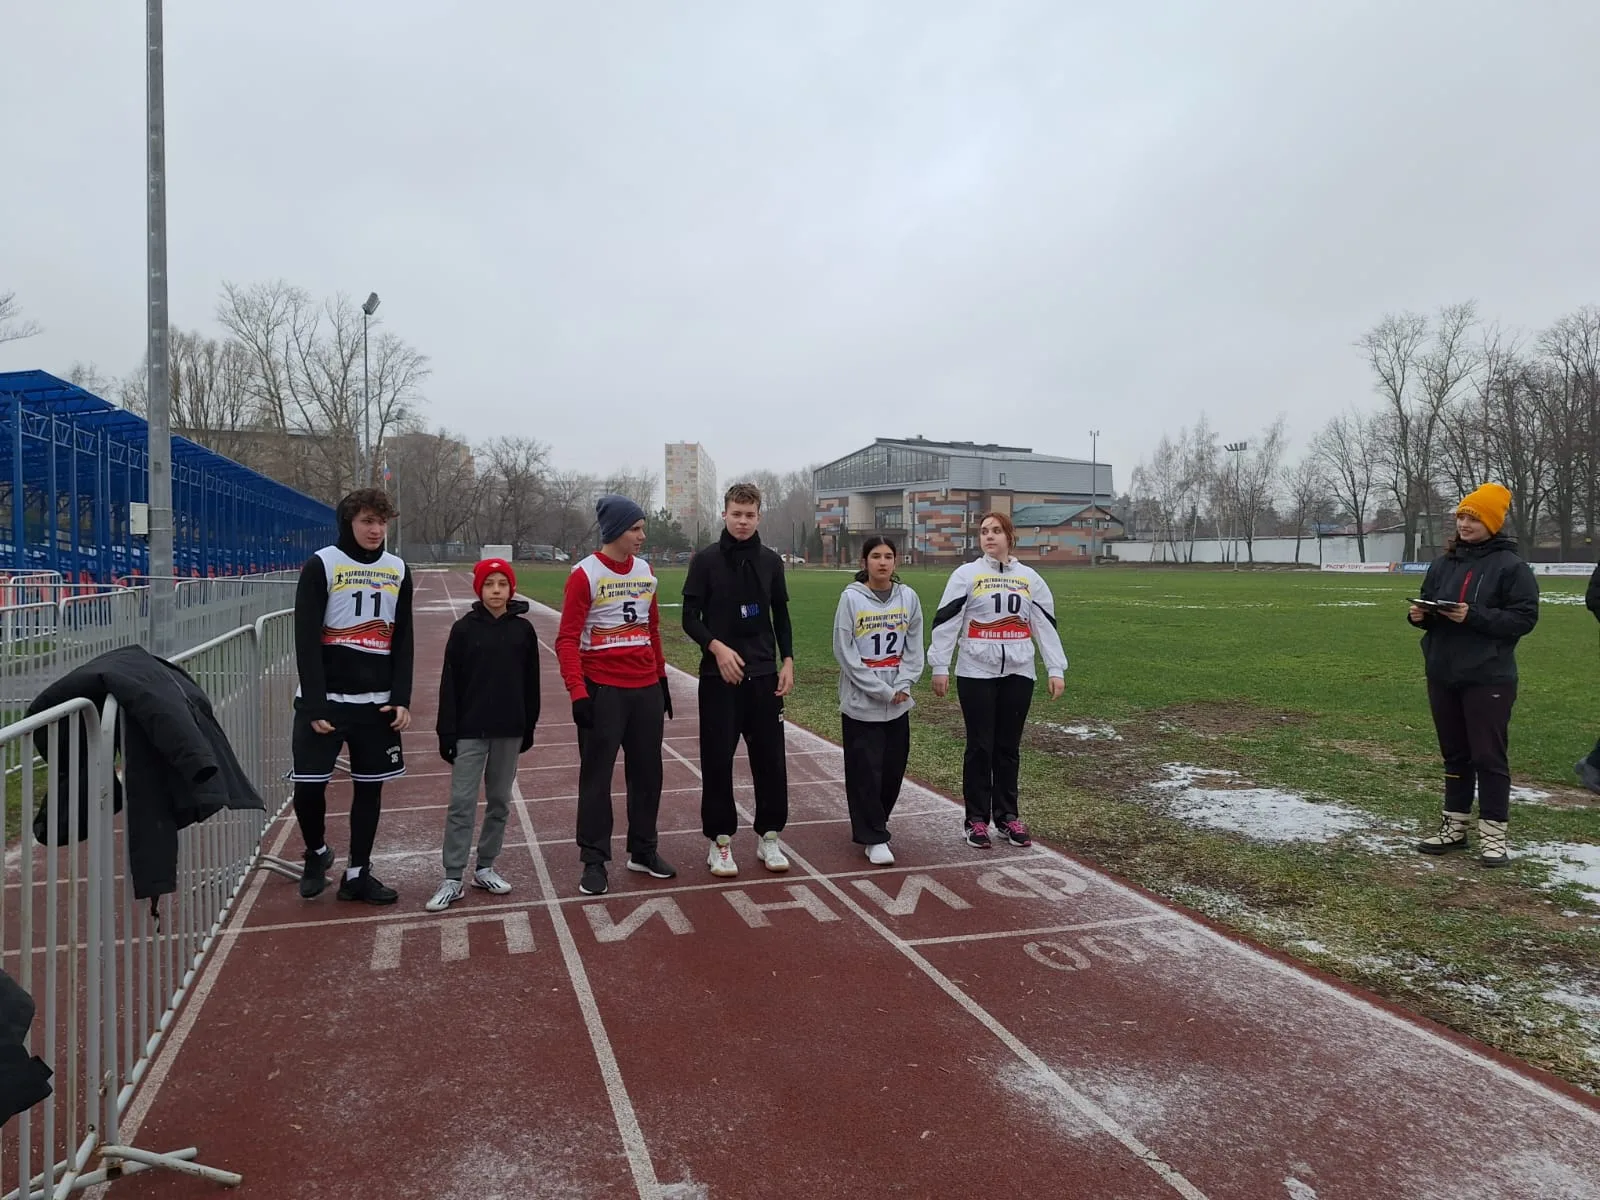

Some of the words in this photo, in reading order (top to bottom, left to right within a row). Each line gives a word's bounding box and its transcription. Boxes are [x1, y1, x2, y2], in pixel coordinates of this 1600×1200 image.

[351, 590, 382, 618] 11
[622, 601, 638, 623] 5
[991, 592, 1021, 615] 10
[871, 631, 898, 656] 12
[368, 866, 1089, 970] ФИНИШ
